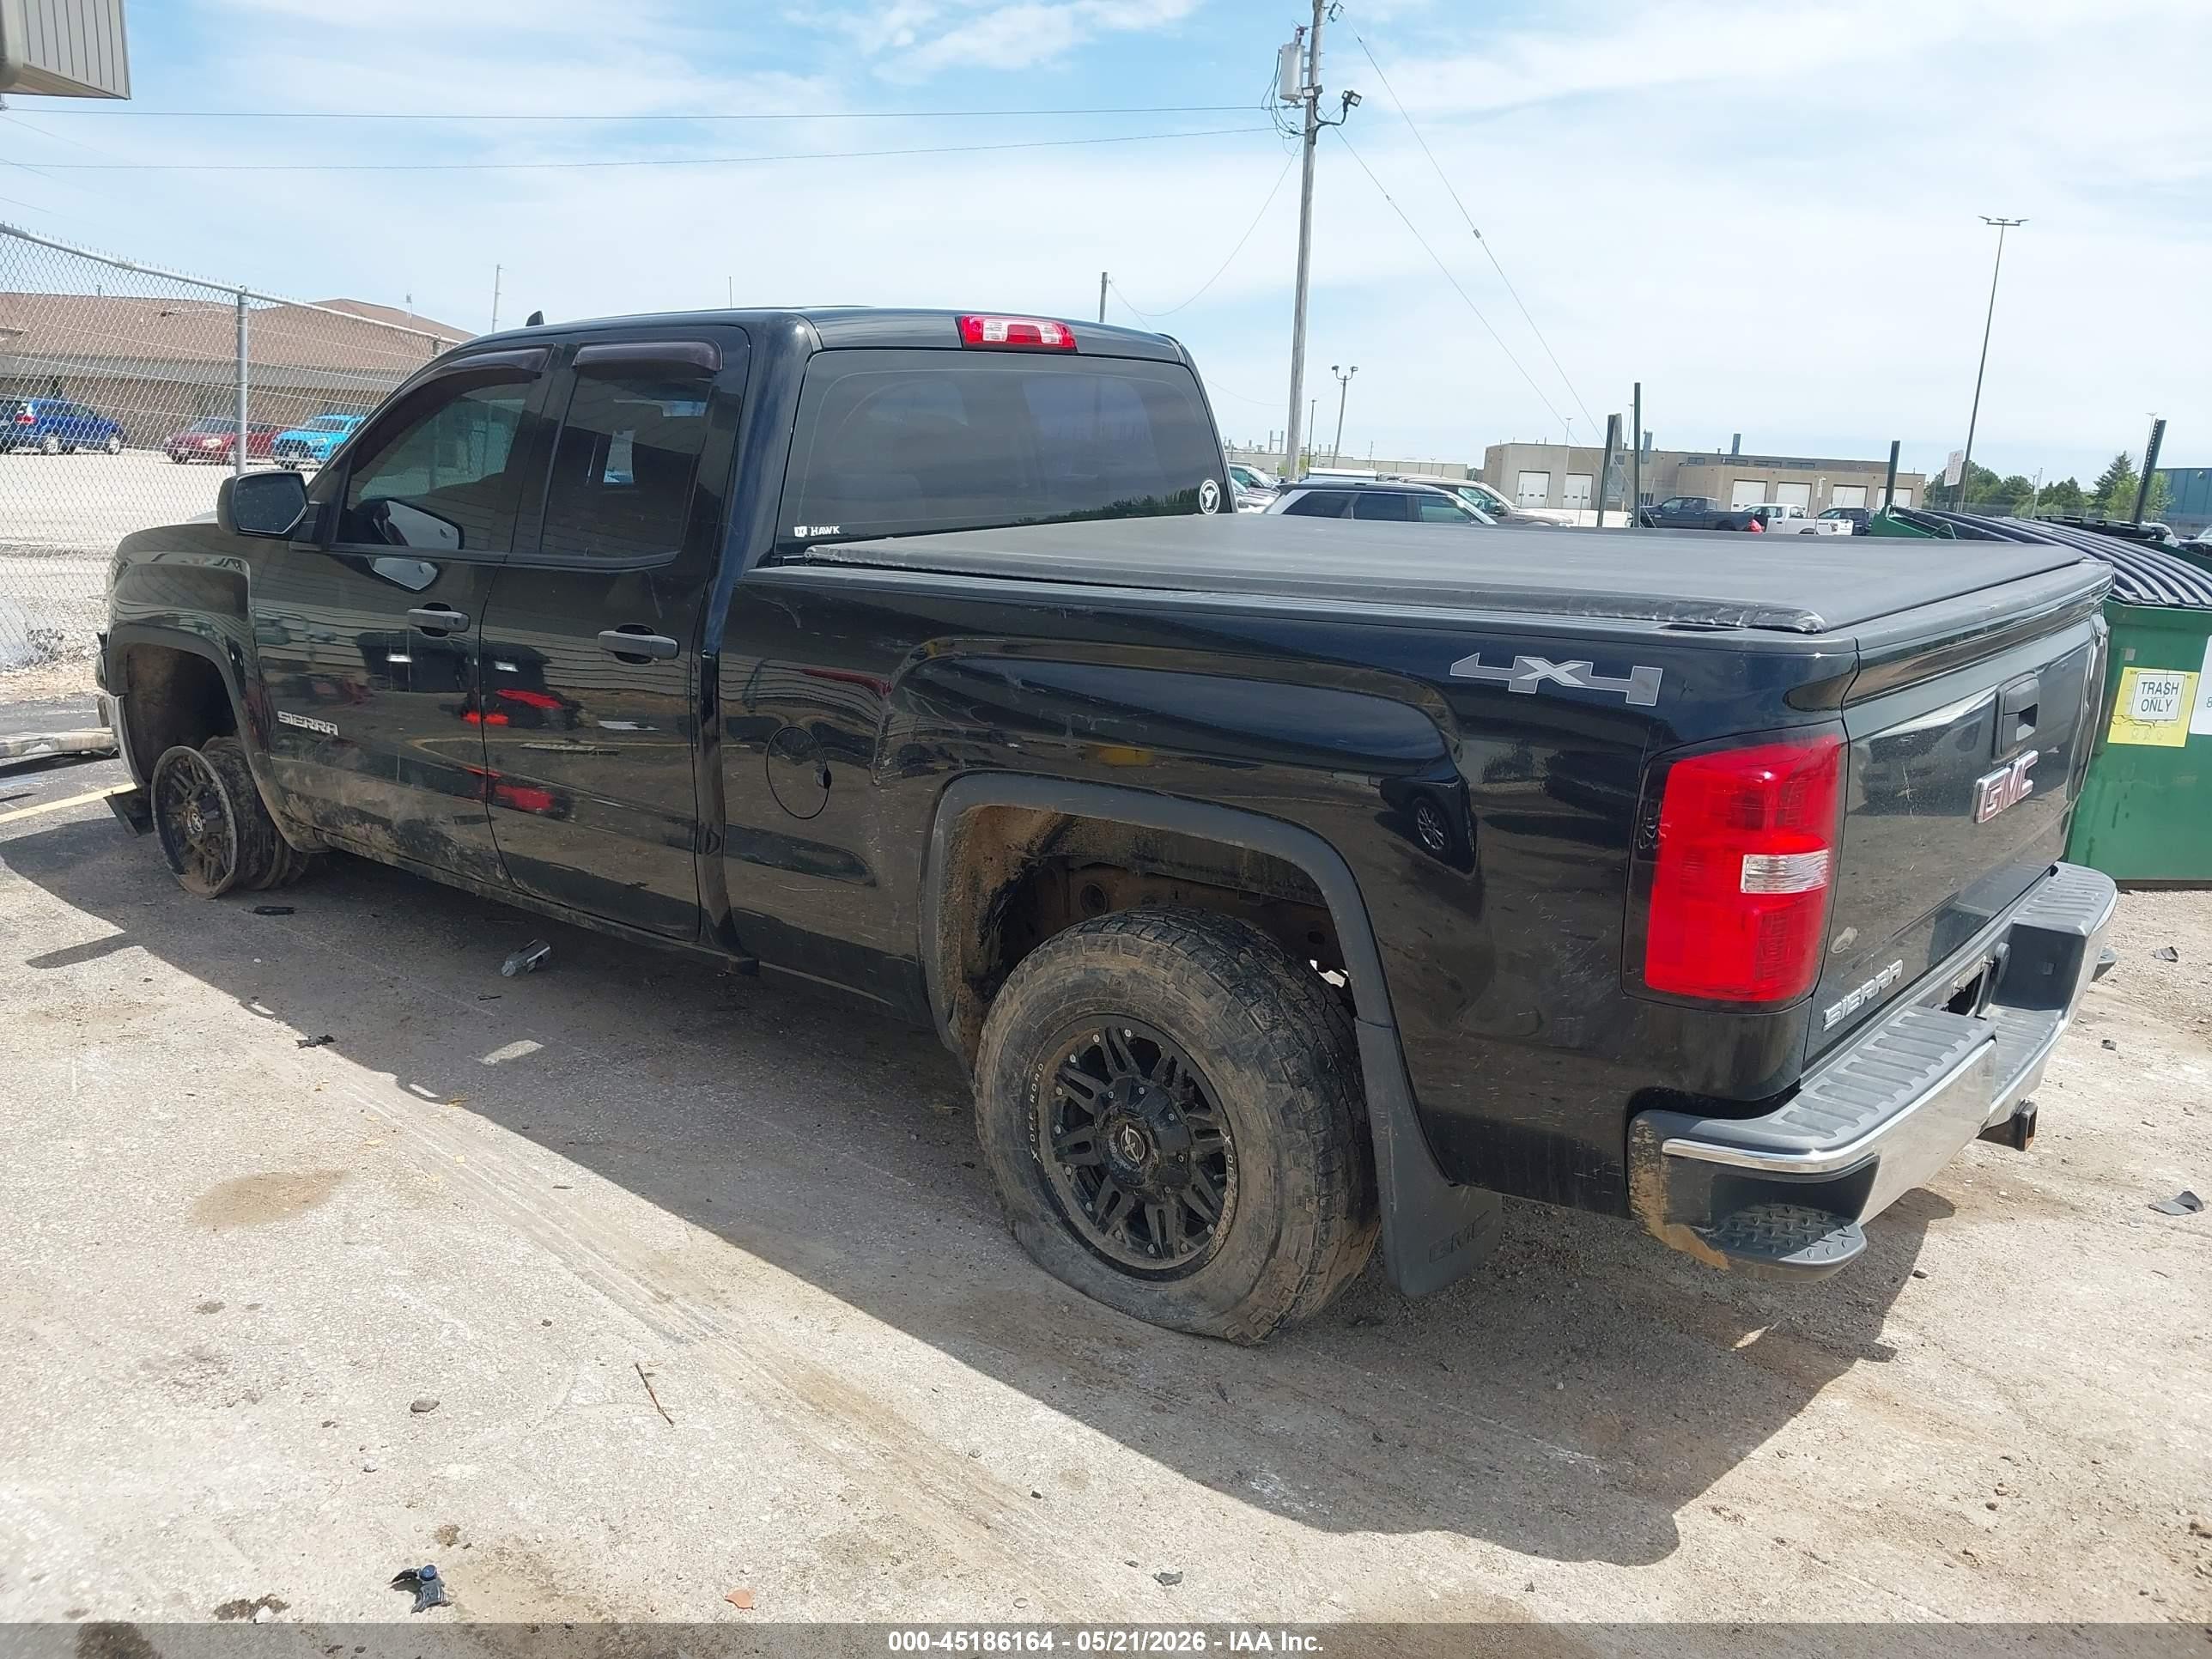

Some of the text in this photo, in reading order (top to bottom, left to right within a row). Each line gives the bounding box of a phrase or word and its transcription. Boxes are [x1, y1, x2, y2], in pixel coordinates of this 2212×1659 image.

[2141, 681, 2179, 696] TRASH
[2141, 698, 2173, 713] ONLY
[277, 710, 339, 736] SIERRA
[1975, 750, 2039, 824] GMC
[1822, 959, 1904, 1031] SIERRA
